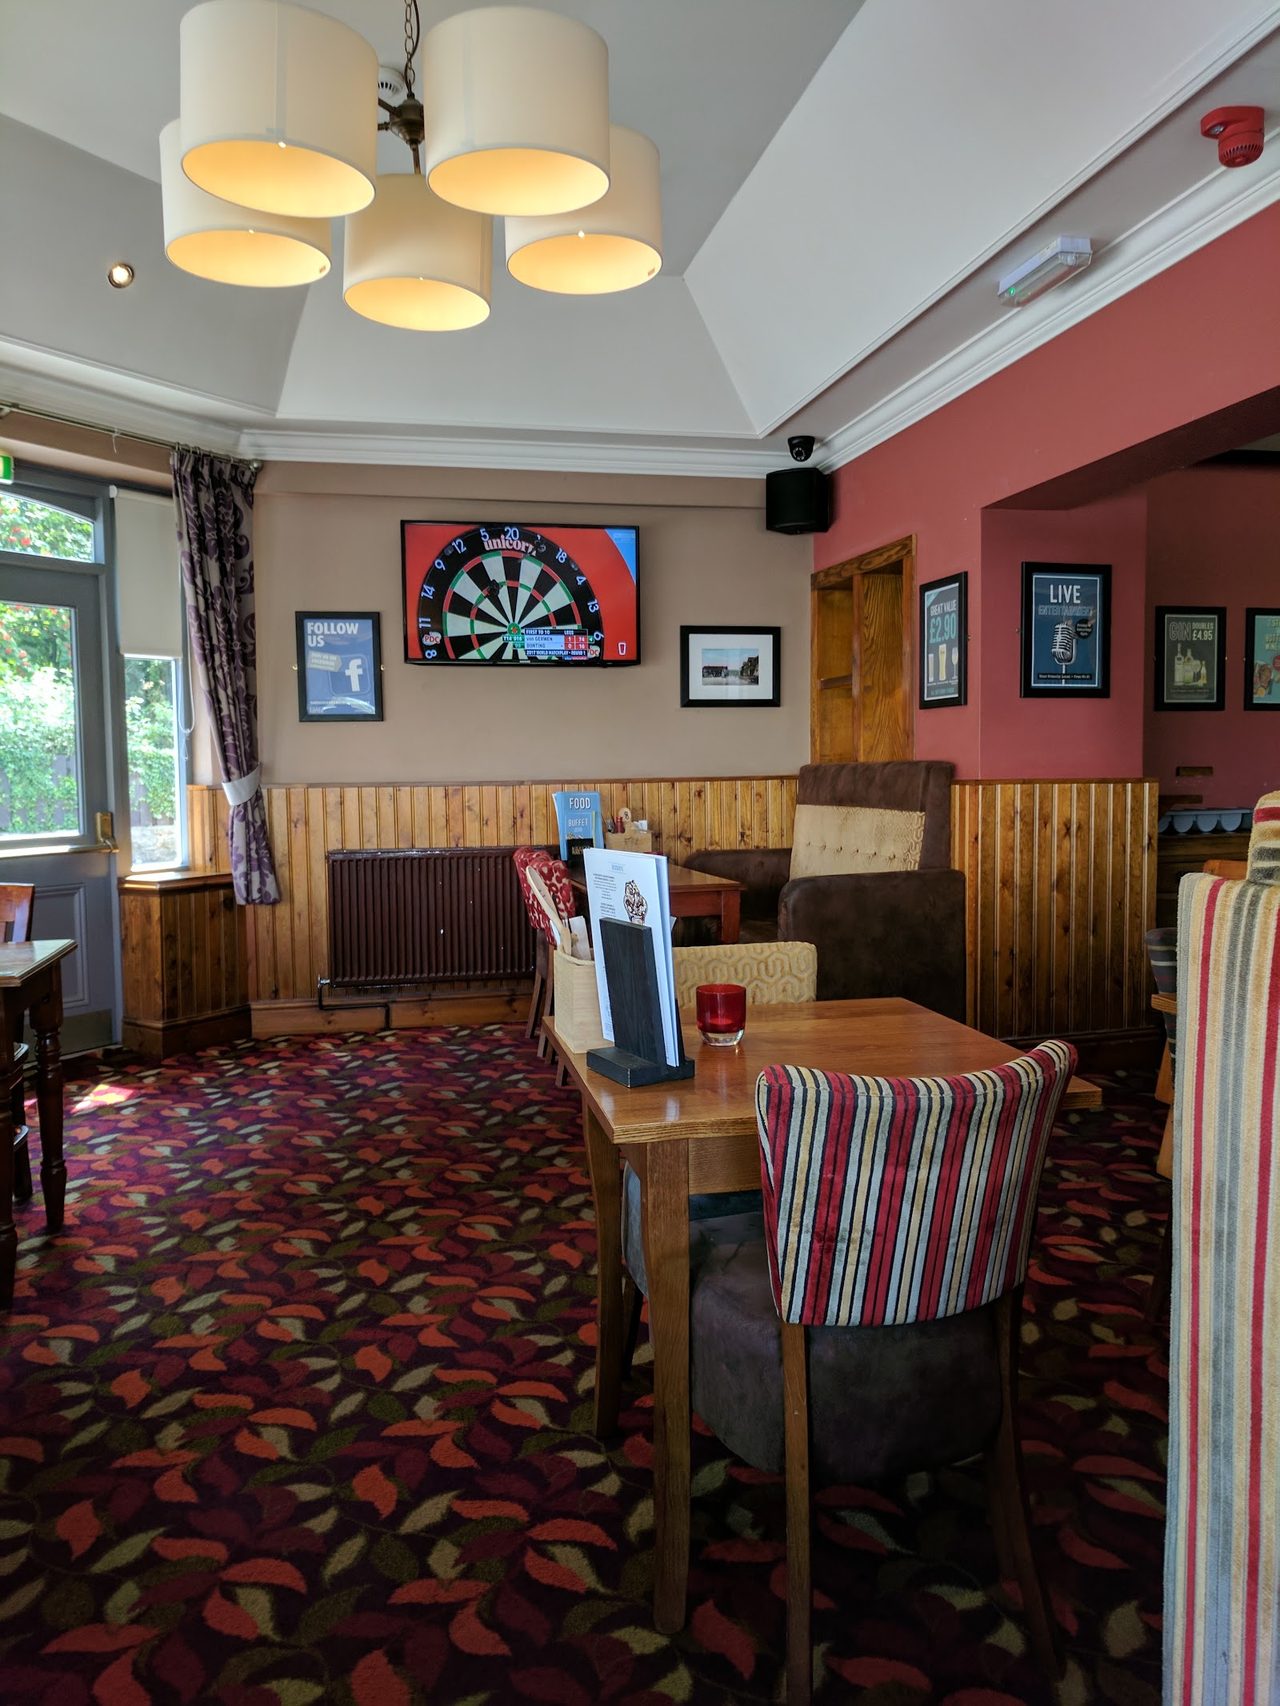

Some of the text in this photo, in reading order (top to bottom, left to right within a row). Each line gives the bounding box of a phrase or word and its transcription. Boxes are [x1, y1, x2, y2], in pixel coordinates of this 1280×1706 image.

[480, 528, 489, 541] 5
[504, 526, 519, 540] 20
[452, 539, 467, 554] 12
[555, 548, 568, 563] 18
[434, 559, 446, 571] 9
[576, 575, 586, 585] 4
[421, 585, 435, 599] 14
[1049, 584, 1081, 604] LIVE
[587, 599, 599, 613] 13
[307, 622, 359, 635] FOLLOW
[929, 612, 957, 644] £2.90
[1169, 621, 1192, 641] GIN
[307, 635, 325, 648] US
[424, 635, 440, 644] PDC
[425, 649, 437, 659] 8
[569, 797, 592, 810] FOOD
[568, 818, 588, 827] BUFFET
